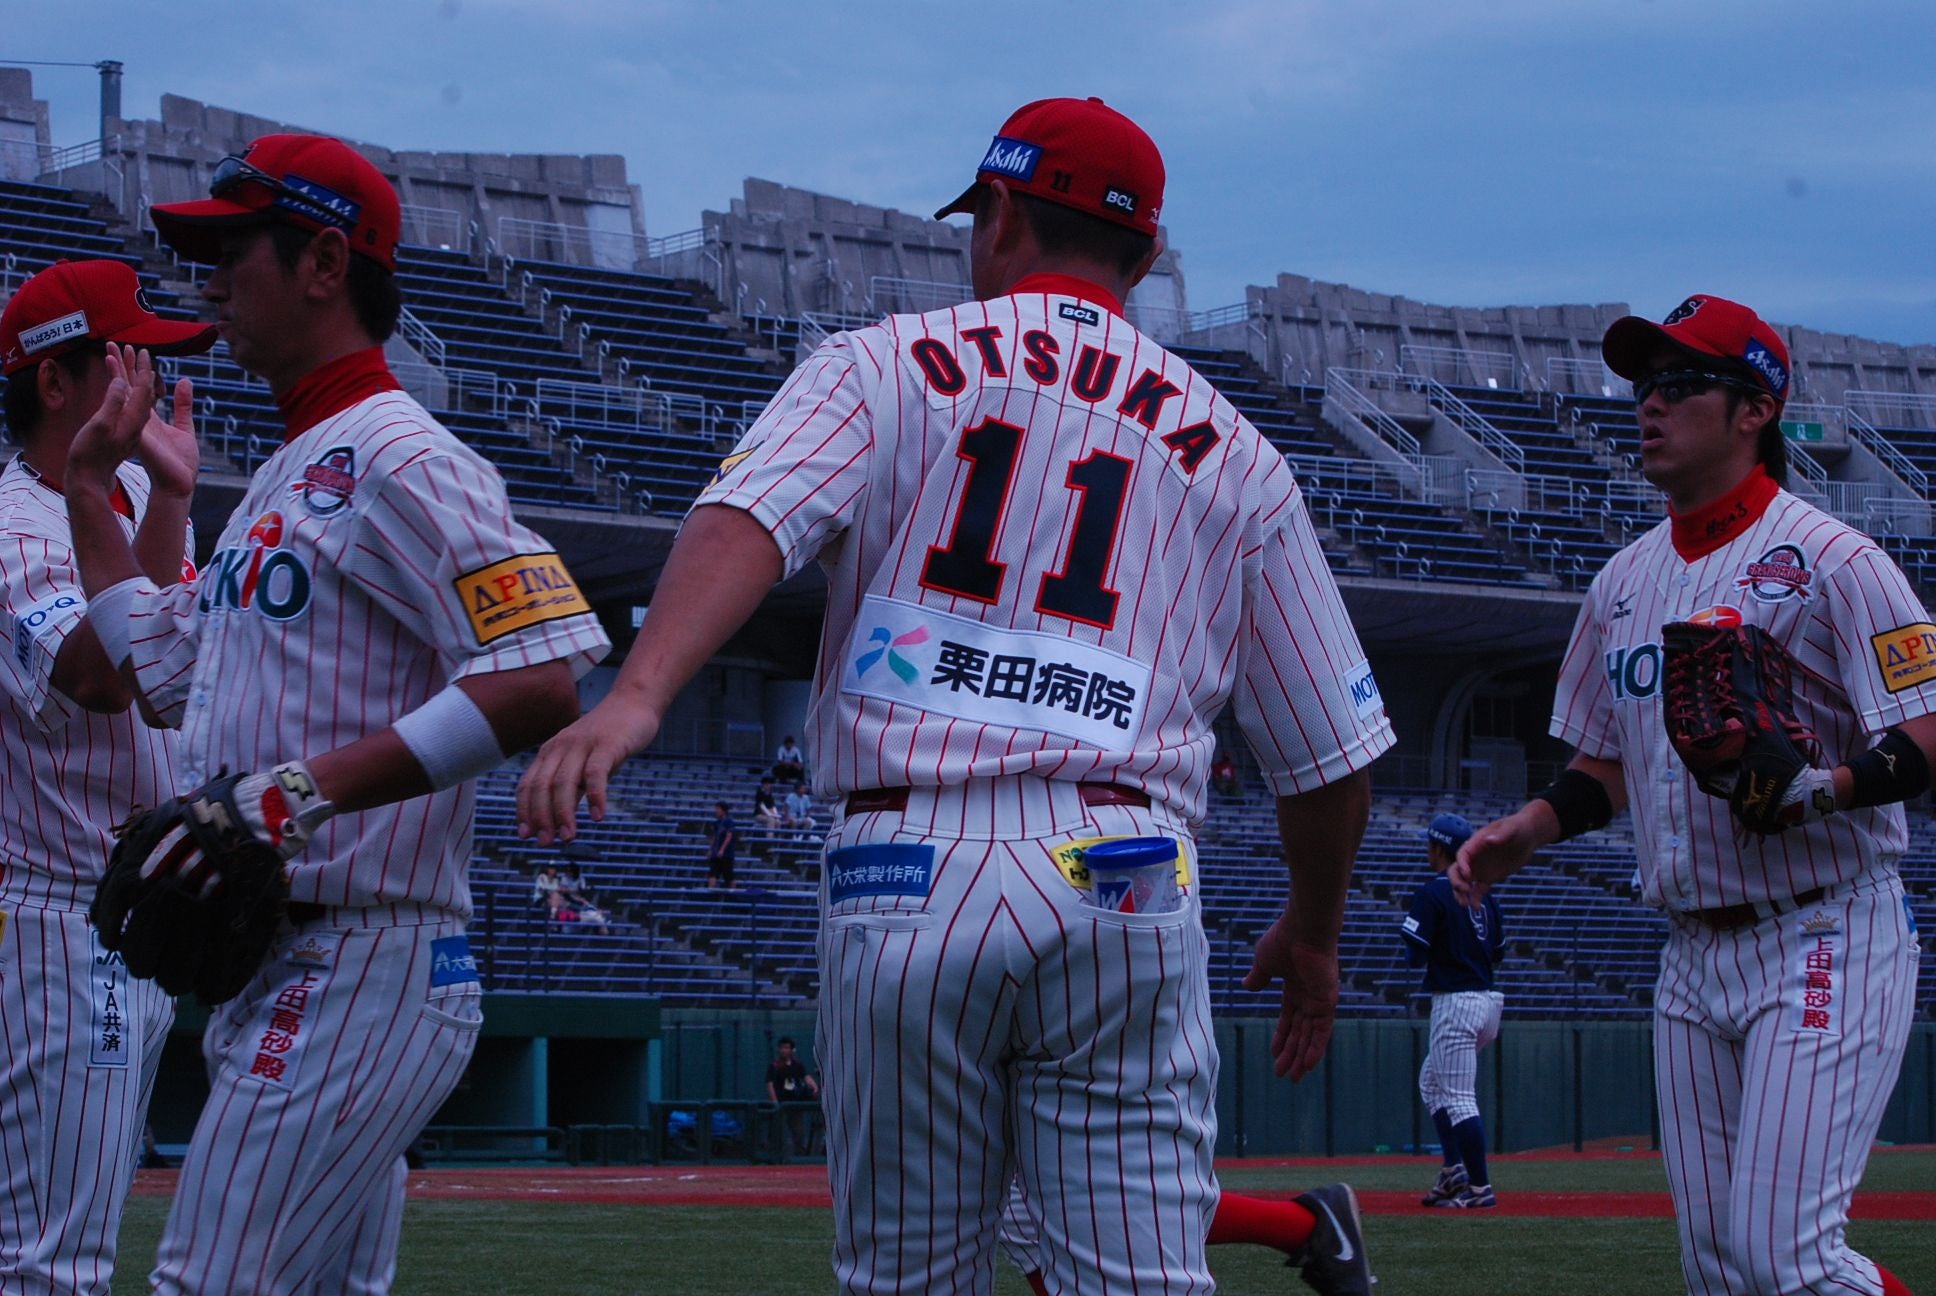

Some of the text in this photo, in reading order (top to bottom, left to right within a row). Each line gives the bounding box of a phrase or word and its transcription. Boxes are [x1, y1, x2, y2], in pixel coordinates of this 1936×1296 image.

[983, 142, 1034, 174] Asahi
[1052, 170, 1074, 194] 11
[1105, 190, 1134, 211] BCL
[1061, 307, 1096, 322] BCL
[1747, 349, 1787, 391] Asahi
[911, 326, 1221, 476] OTSUKA
[917, 414, 1134, 632] 11
[475, 565, 572, 614] APINA
[1886, 632, 1936, 668] API
[930, 640, 1136, 731] 栗田病院
[842, 864, 927, 887] 大栄製作所
[1801, 936, 1835, 1031] 上田高砂殿
[101, 970, 122, 1052] JA共済
[249, 968, 320, 1083] 上田高砂殿
